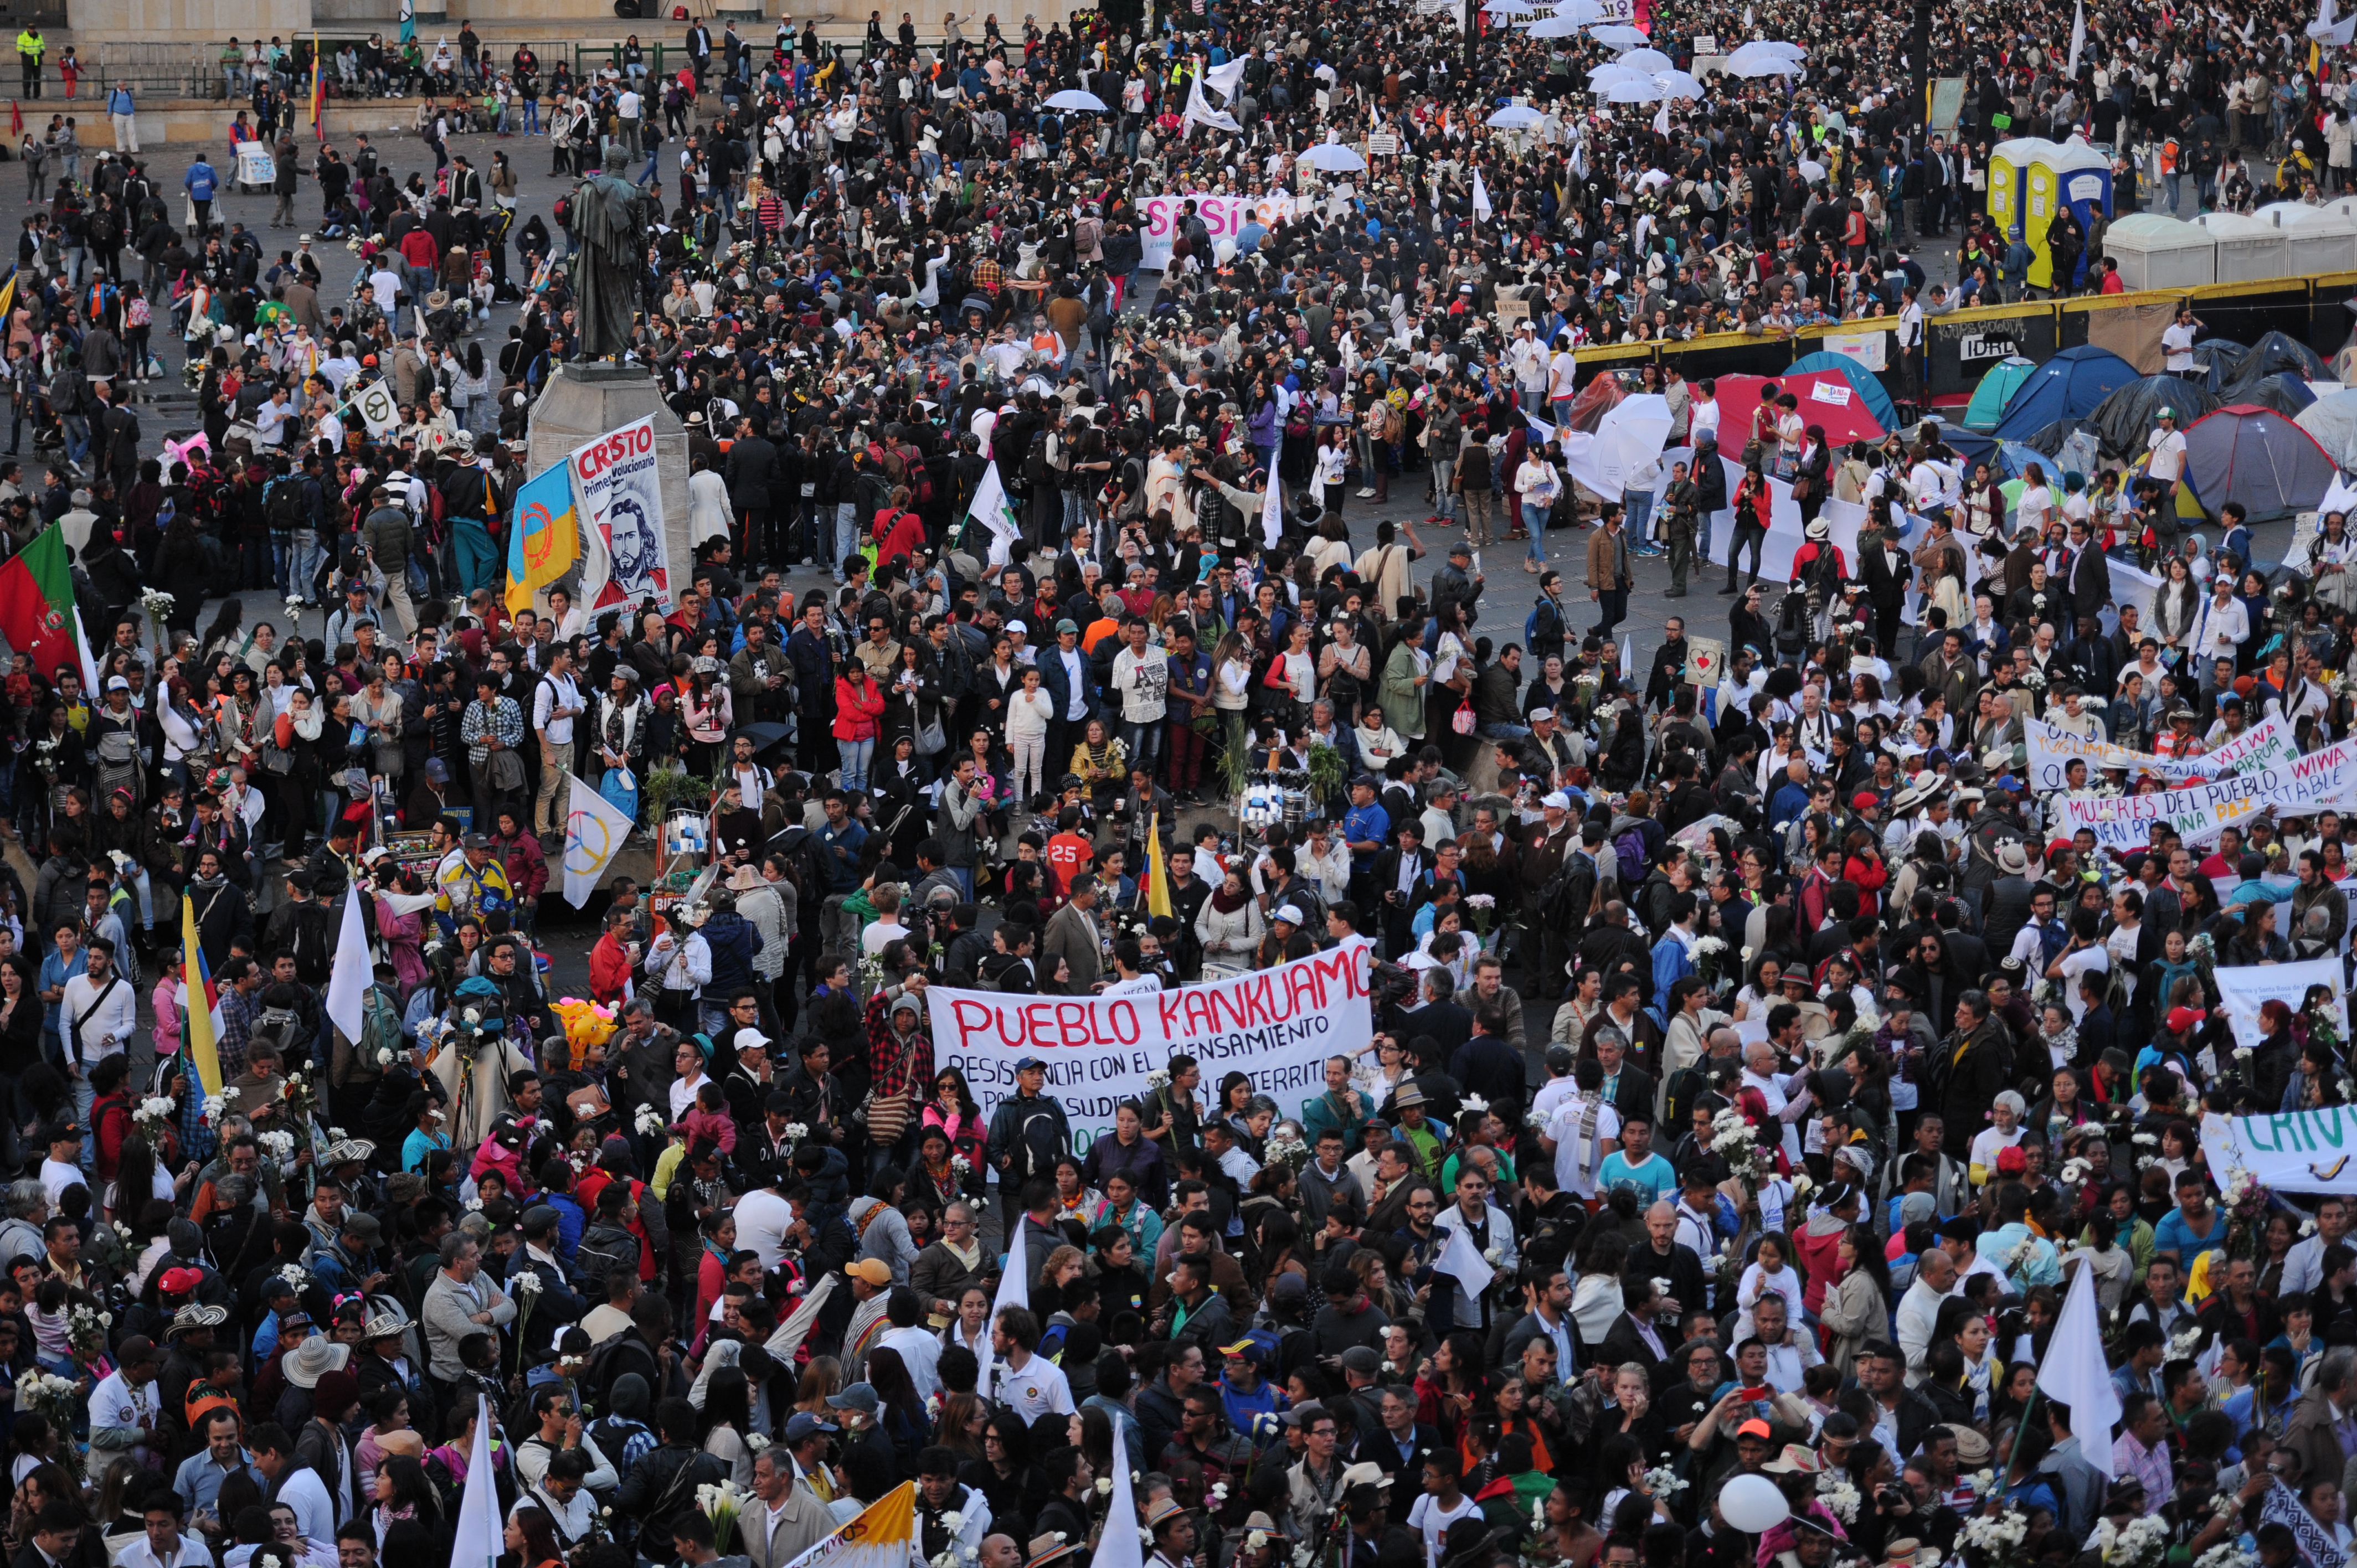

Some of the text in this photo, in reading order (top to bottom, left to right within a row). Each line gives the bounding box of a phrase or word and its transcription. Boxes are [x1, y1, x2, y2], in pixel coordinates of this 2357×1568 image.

[1200, 199, 1241, 236] Sí
[578, 425, 652, 480] CRISTO
[612, 453, 655, 478] volucionario
[622, 603, 638, 616] LFA
[655, 595, 669, 606] EGA
[2211, 724, 2276, 766] WIWA
[2068, 747, 2349, 823] MUJERES DEL PUEBLO WIWA
[2169, 811, 2209, 834] UNA
[2215, 797, 2254, 822] PAZ
[1051, 845, 1077, 863] 25
[2108, 941, 2135, 951] HENDRIX
[951, 999, 1141, 1048] PUEBLO
[1090, 1053, 1126, 1081] CON
[1133, 1051, 1156, 1074] EL
[1248, 1059, 1328, 1094] TERRIT
